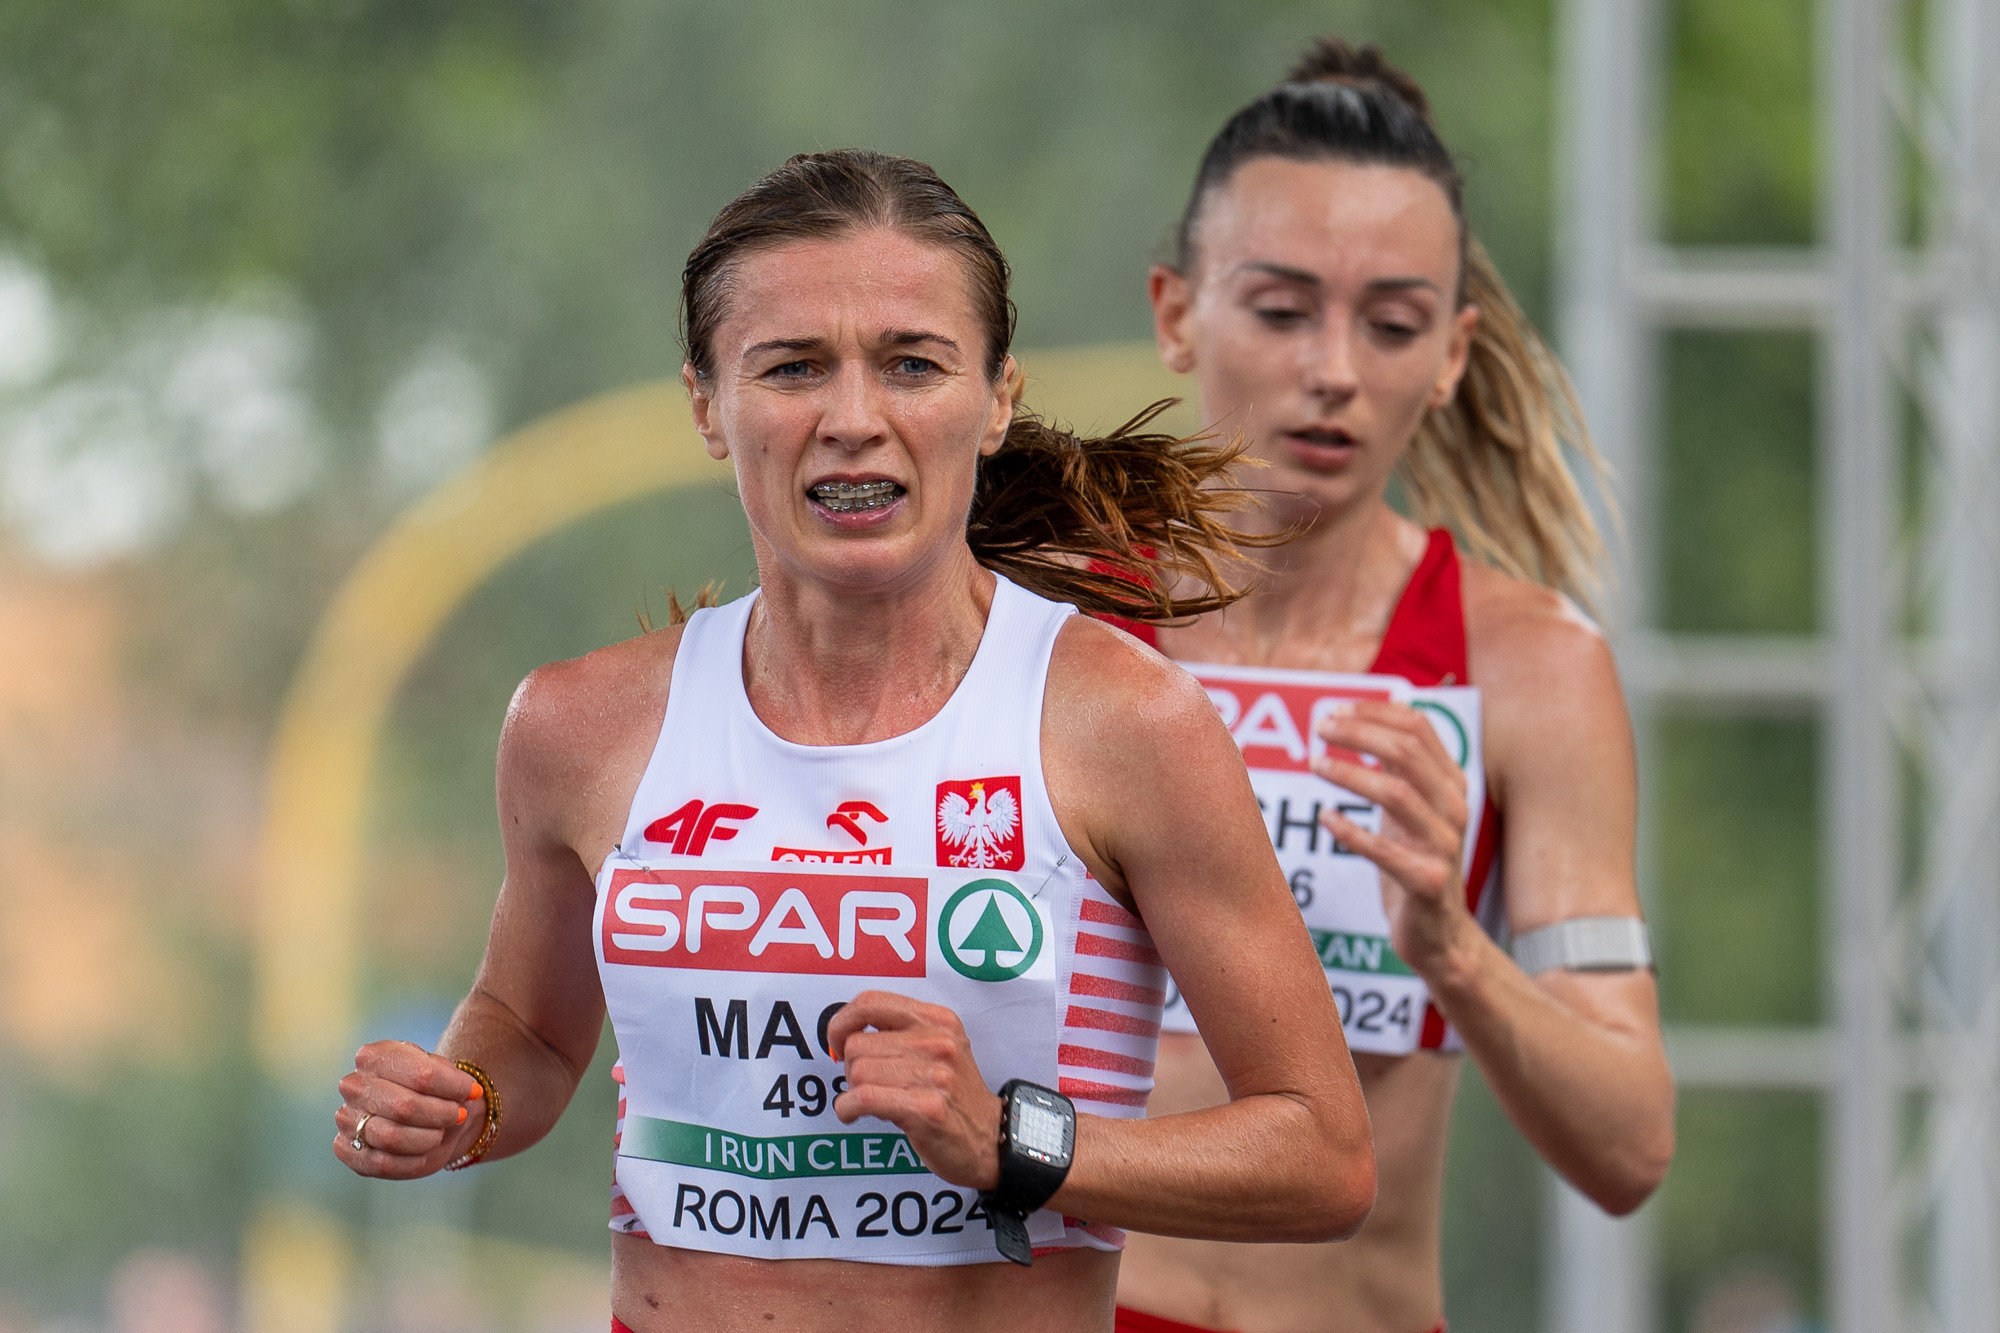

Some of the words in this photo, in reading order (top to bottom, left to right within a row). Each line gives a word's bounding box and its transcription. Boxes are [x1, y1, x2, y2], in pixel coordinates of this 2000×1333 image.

[643, 798, 759, 857] 4F
[611, 882, 918, 964] SPAR
[705, 1132, 713, 1164] I
[720, 1135, 796, 1174] RUN
[807, 1138, 926, 1171] CLEA
[672, 1182, 840, 1241] ROMA
